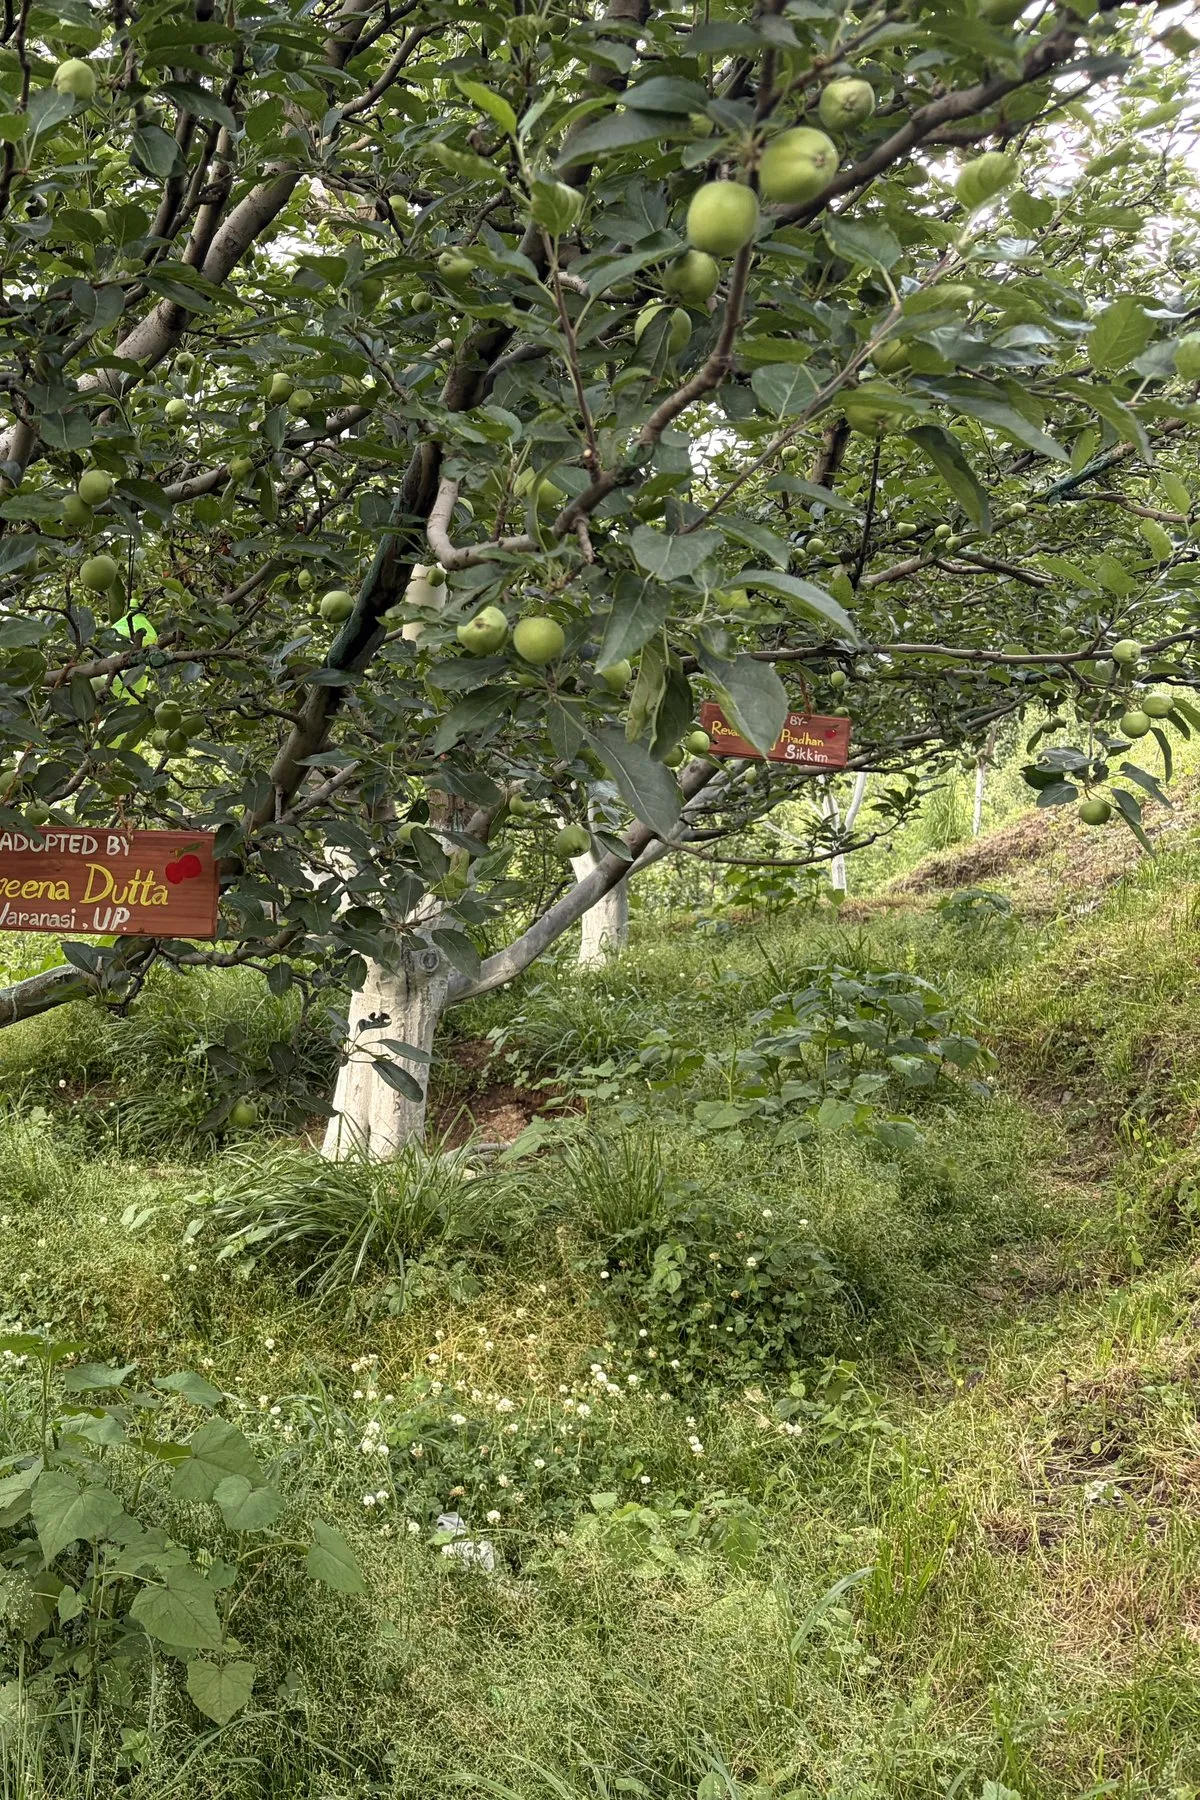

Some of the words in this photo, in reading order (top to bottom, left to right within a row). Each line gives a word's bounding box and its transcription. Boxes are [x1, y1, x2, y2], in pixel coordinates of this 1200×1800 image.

[781, 729, 825, 747] Pradhan
[785, 744, 829, 763] Sikkim
[105, 834, 134, 857] BY
[79, 863, 169, 907] Dutta
